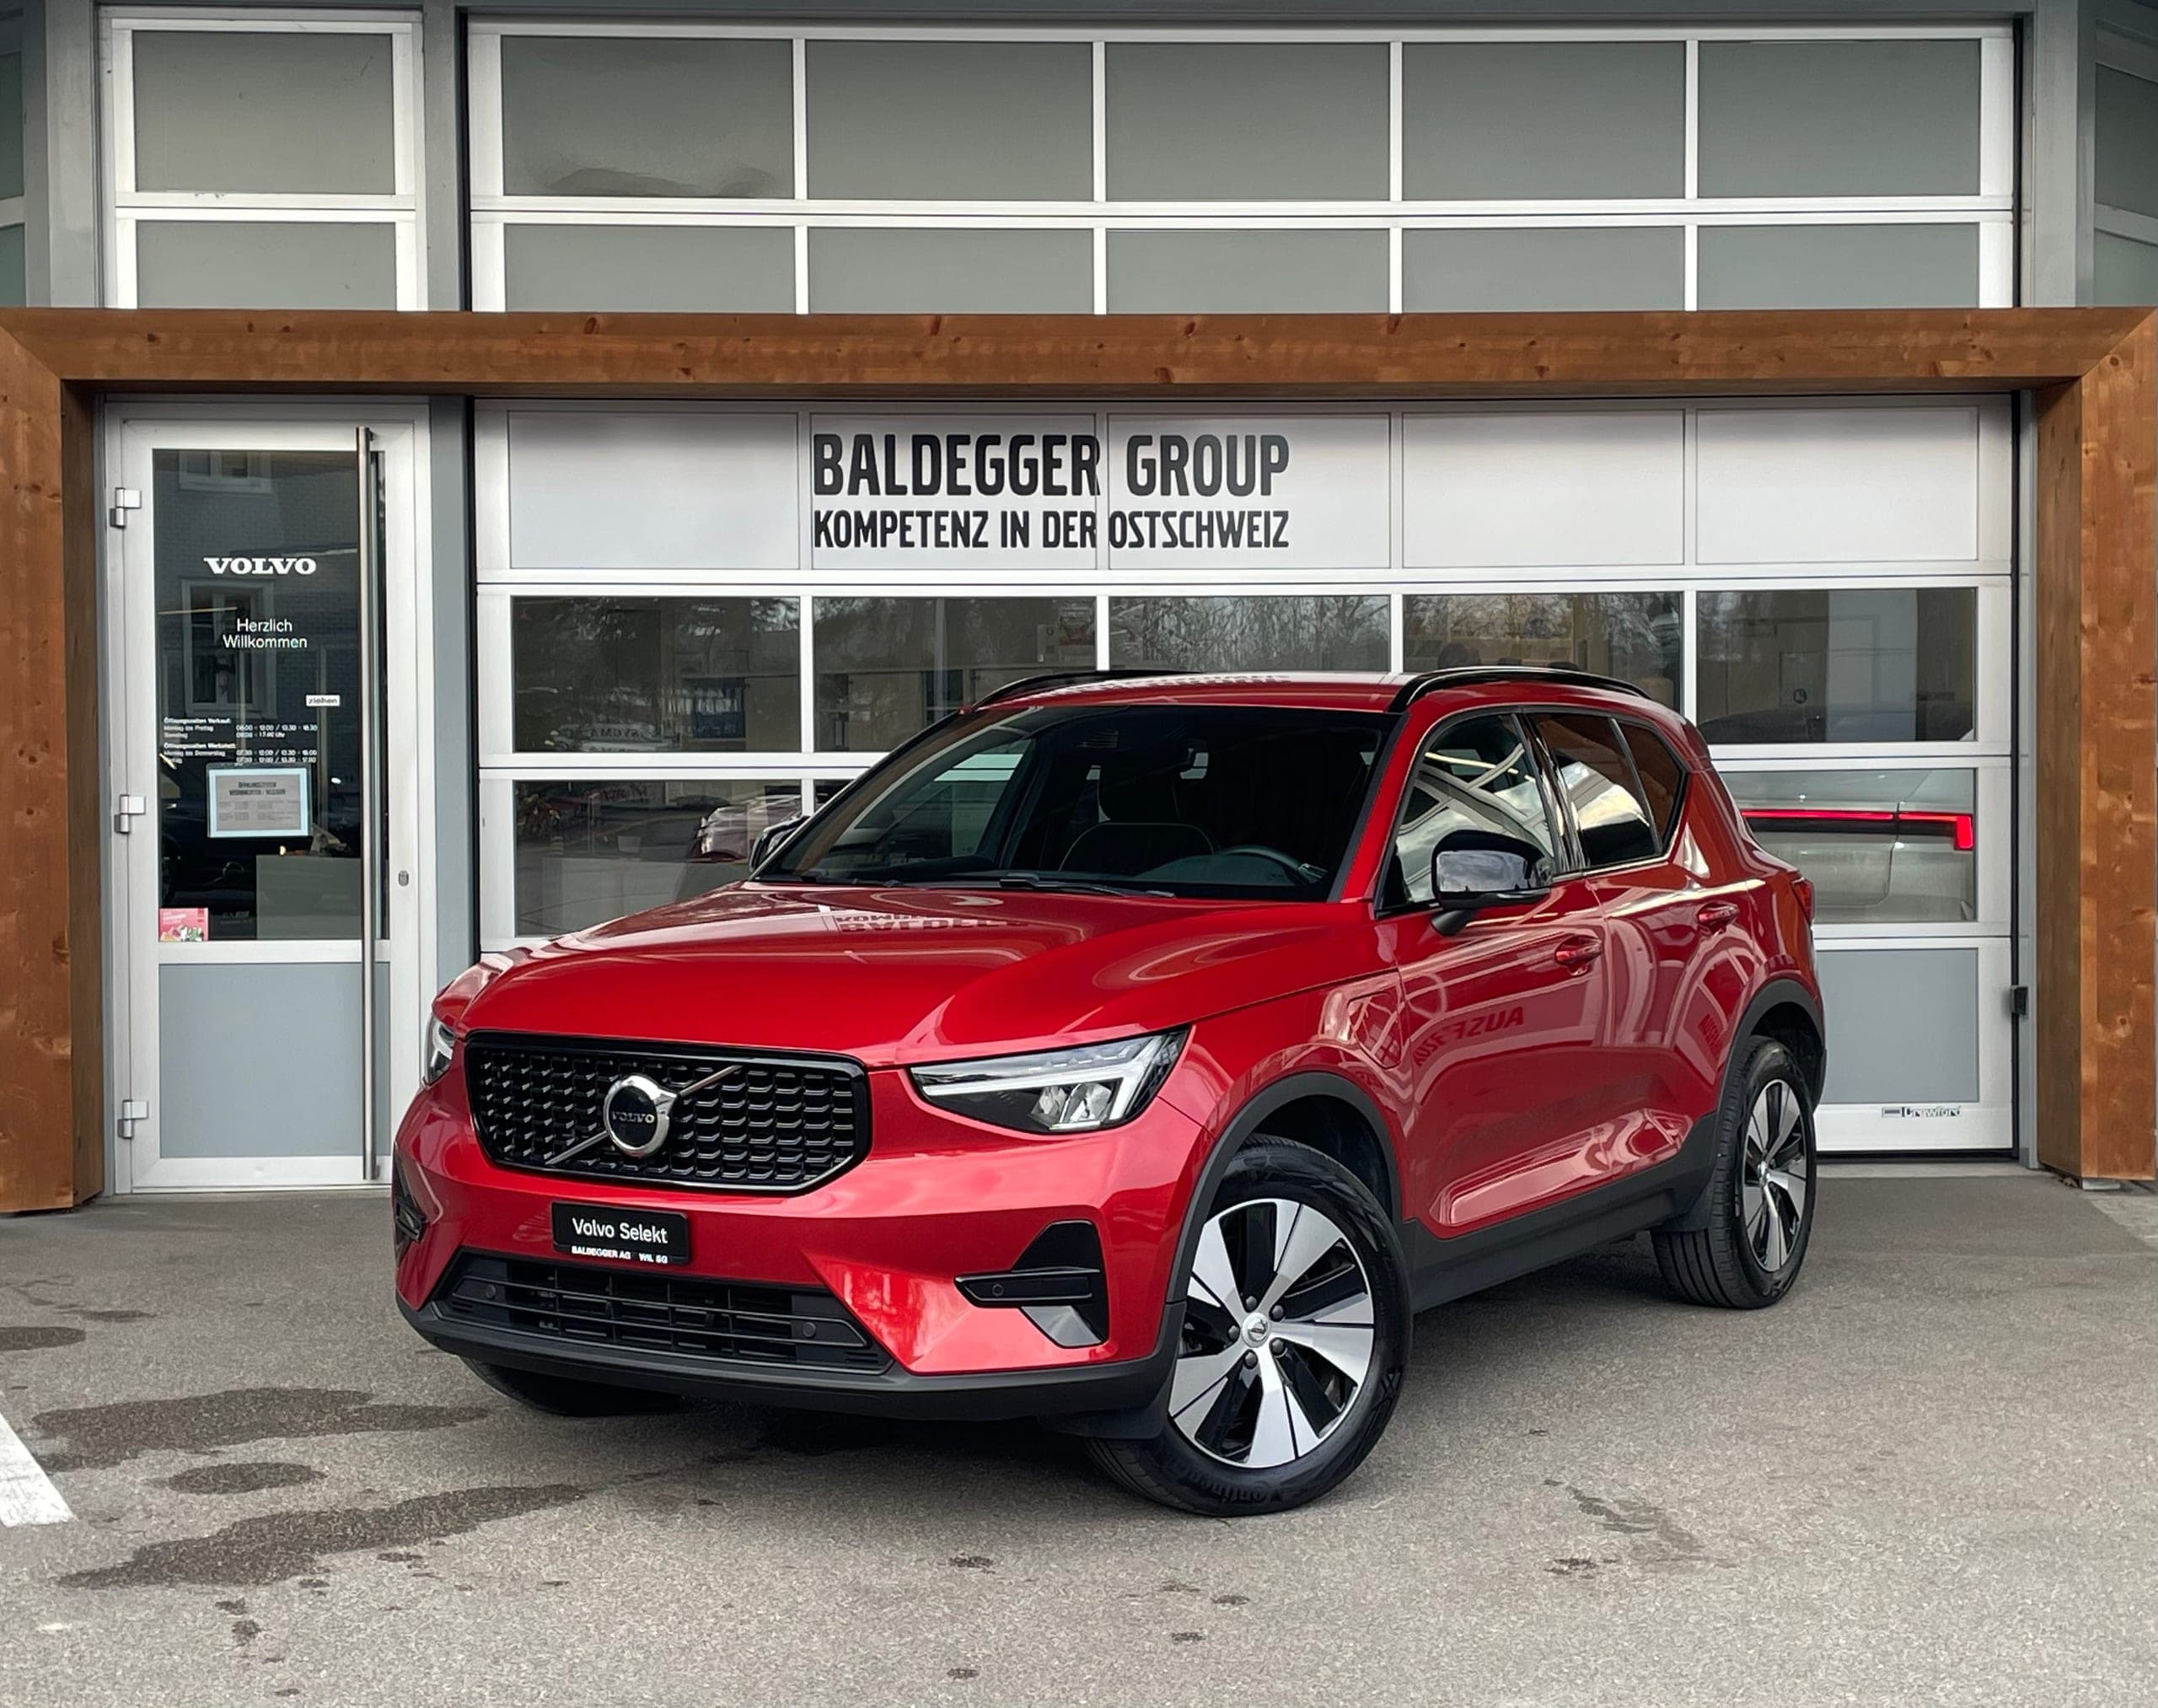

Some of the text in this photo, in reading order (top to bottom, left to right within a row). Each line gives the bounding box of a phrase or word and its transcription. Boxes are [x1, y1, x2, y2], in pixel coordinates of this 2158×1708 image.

[813, 433, 1290, 497] BALDEGGER GROUP
[813, 510, 1290, 548] KOMPETENZ IN DER OSTSCHWEIZ
[203, 557, 317, 575] VOLVO
[236, 617, 293, 632] Herzlich
[223, 634, 308, 648] Willkommen
[572, 1217, 668, 1244] Volvo Selekt
